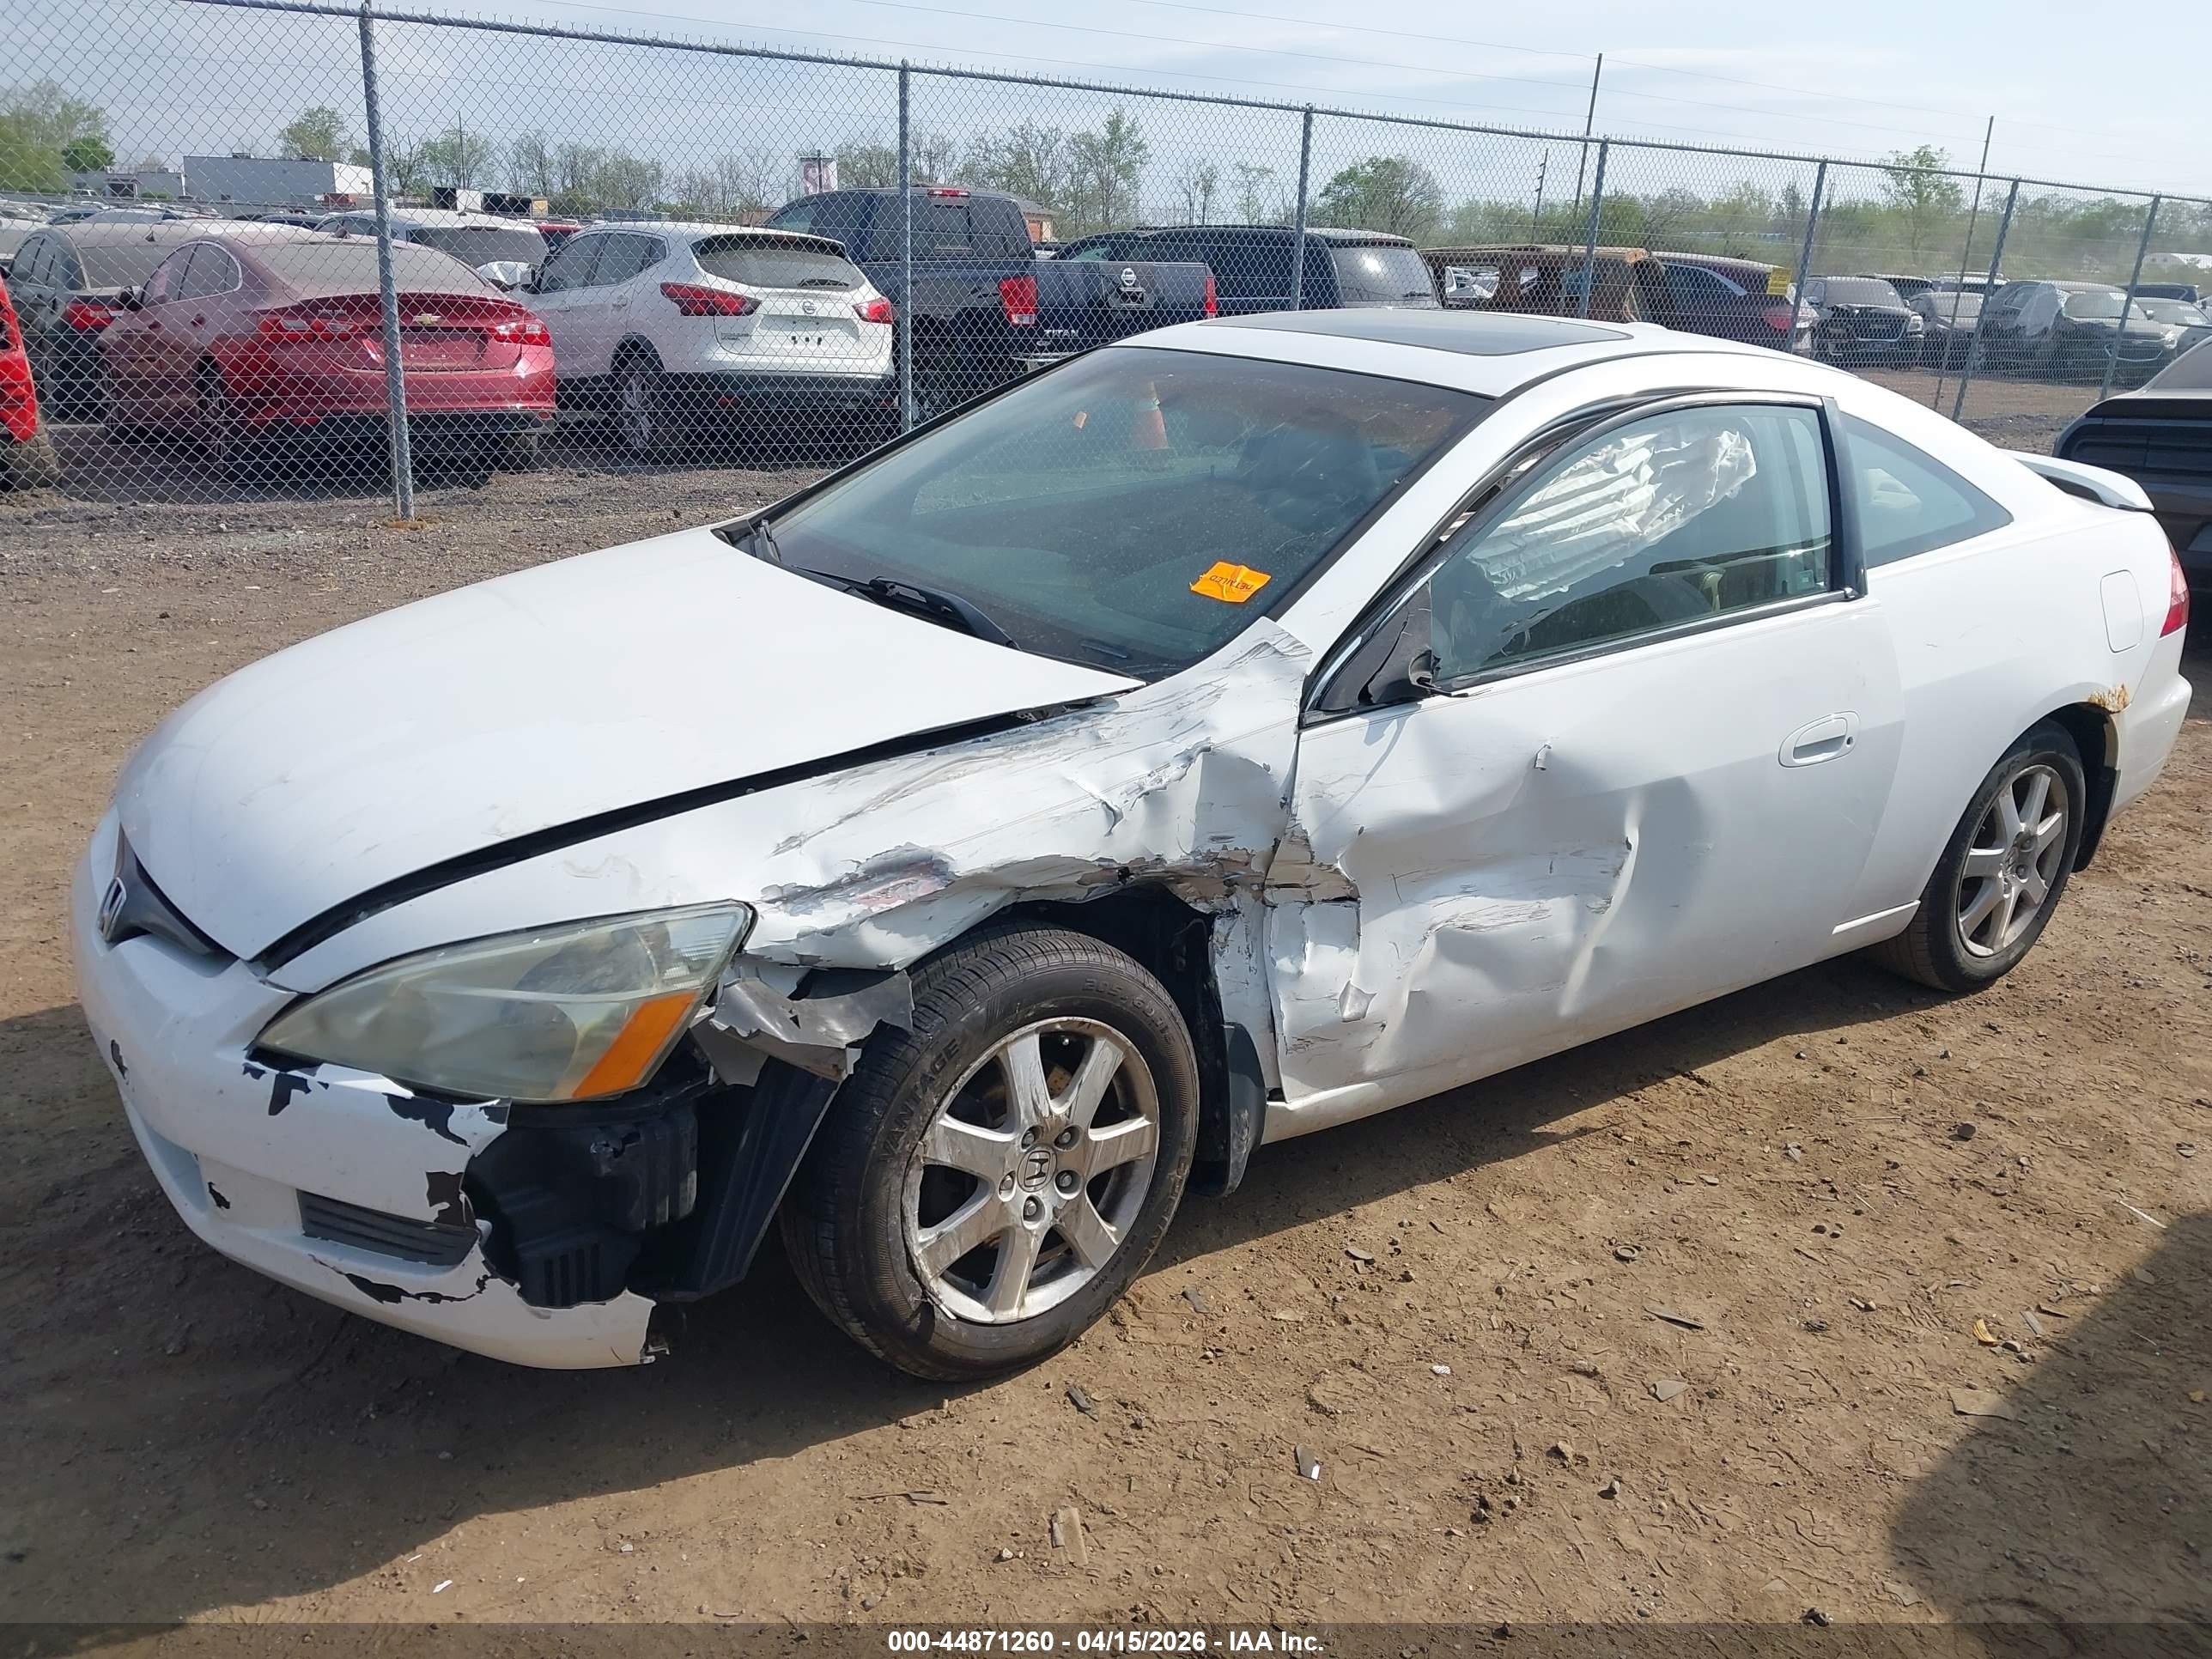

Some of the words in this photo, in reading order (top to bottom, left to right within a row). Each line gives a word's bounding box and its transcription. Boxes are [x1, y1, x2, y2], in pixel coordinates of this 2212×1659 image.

[1043, 329, 1079, 337] TITAN
[1209, 574, 1254, 590] DETAILED
[880, 1038, 959, 1160] VANTAGE
